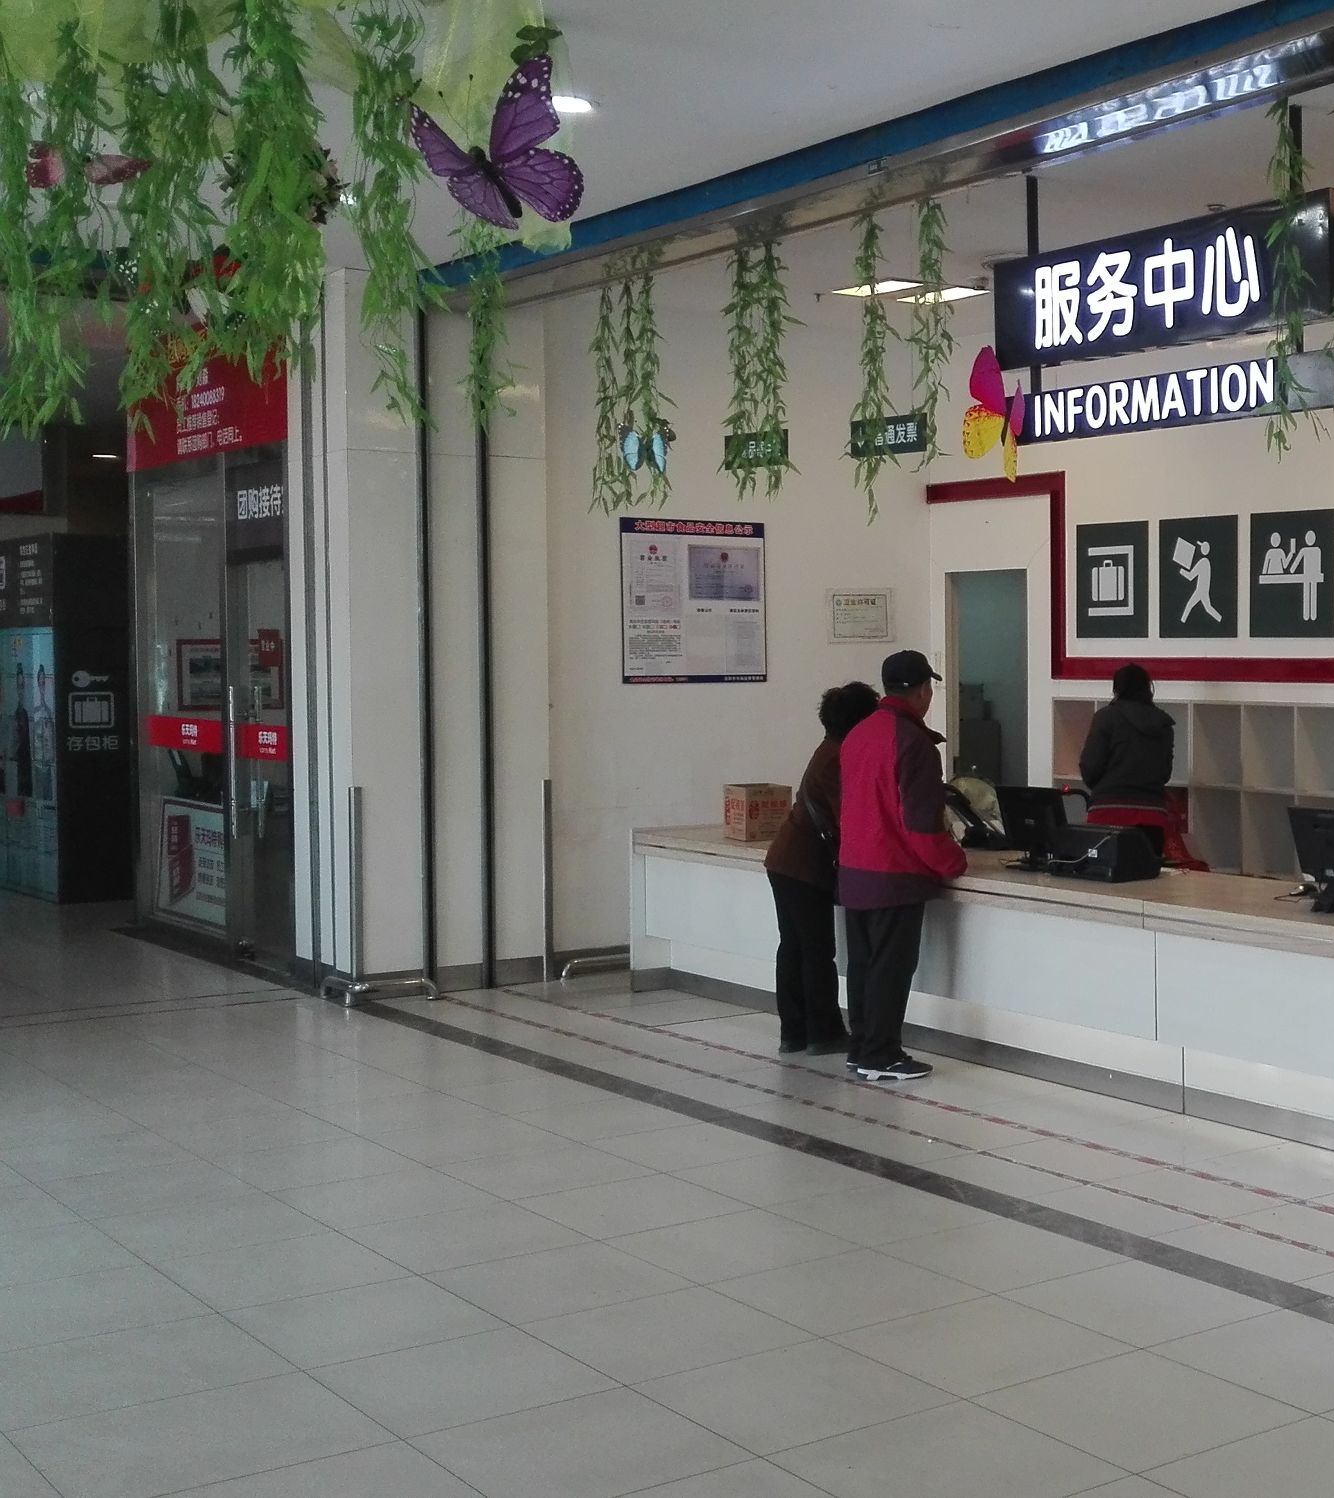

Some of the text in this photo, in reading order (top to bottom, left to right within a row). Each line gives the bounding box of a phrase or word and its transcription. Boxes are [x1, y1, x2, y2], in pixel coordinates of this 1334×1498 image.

[1034, 226, 1262, 350] 服务中心
[1034, 358, 1275, 437] INFORMATION
[238, 484, 284, 521] 团购接待
[66, 735, 120, 753] 存包柜
